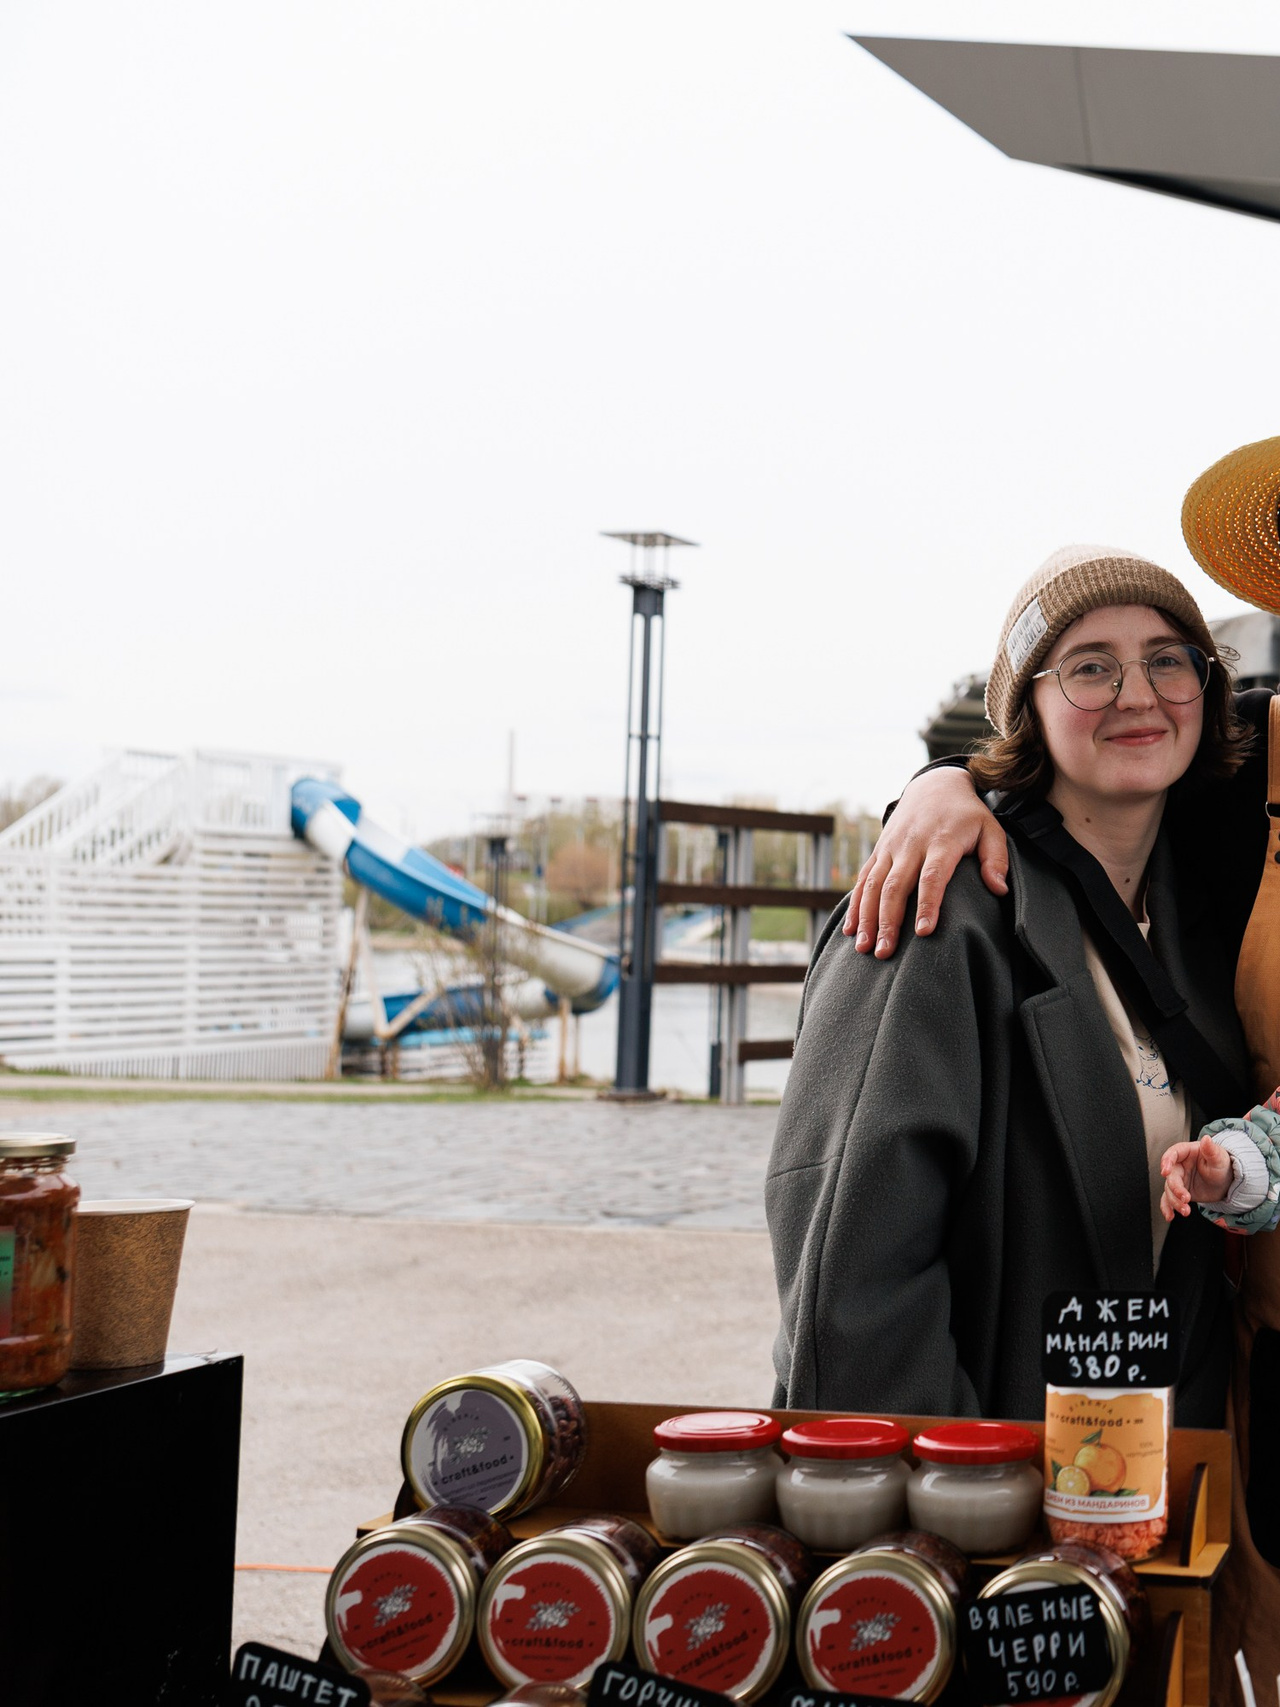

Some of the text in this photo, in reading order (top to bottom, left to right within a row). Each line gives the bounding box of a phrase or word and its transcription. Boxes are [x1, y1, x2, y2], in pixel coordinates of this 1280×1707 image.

[1058, 1297, 1169, 1323] ДЖЕМ
[1046, 1331, 1168, 1353] МАНДАРИН
[1068, 1355, 1120, 1380] 380
[1061, 1415, 1123, 1427] craft&food
[441, 1454, 508, 1485] craft&food
[1078, 1499, 1146, 1509] МАНДАРИНОВ
[511, 1637, 584, 1649] craft&food
[988, 1631, 1086, 1668] ЧЕРРИ
[838, 1647, 912, 1672] craft&food
[239, 1652, 358, 1707] ПАШТЕТ
[1007, 1669, 1057, 1697] 590
